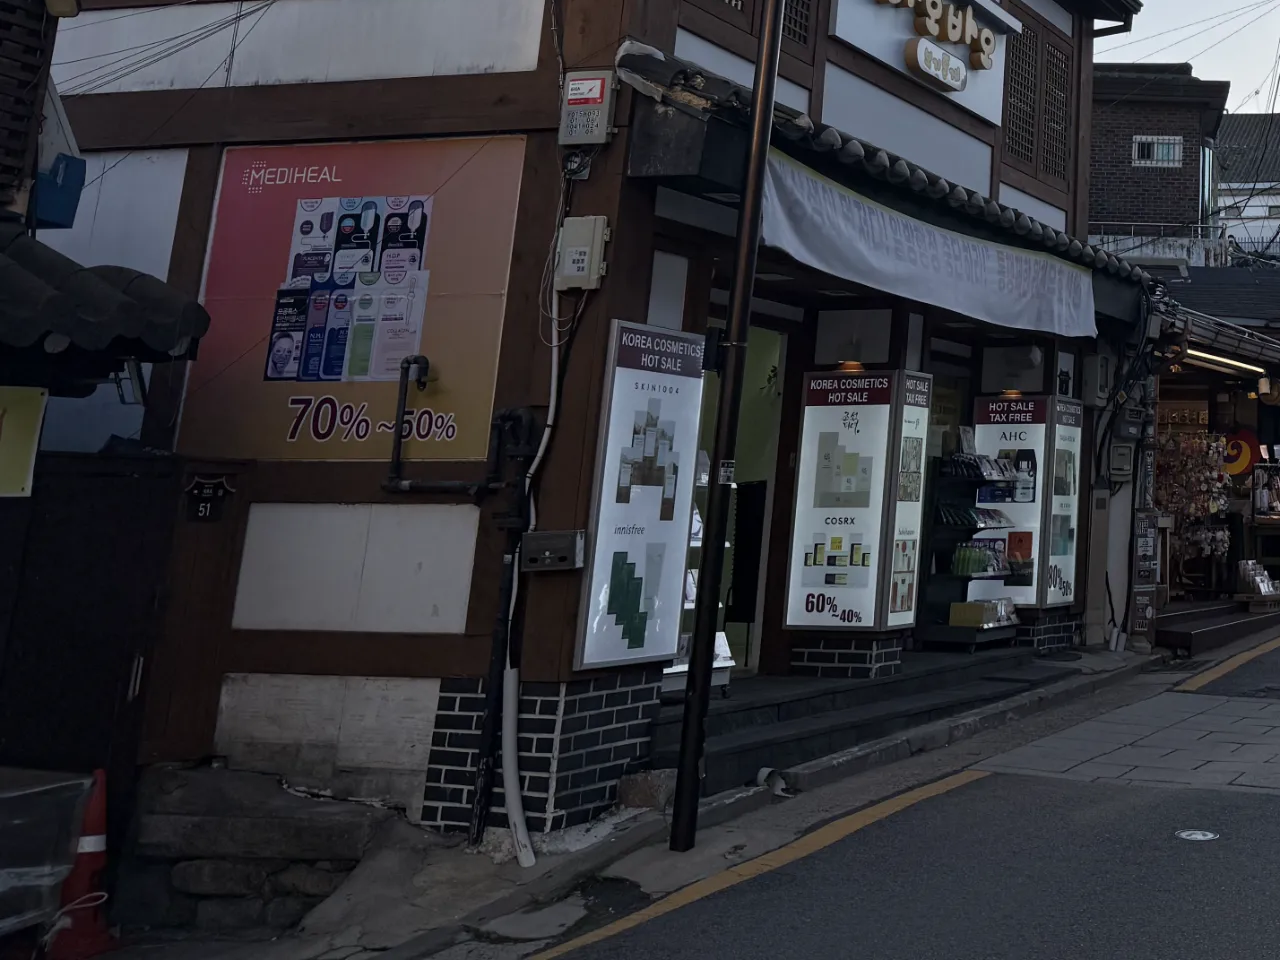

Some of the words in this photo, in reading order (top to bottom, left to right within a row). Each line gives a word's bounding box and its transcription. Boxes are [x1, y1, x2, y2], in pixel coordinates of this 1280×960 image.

[249, 166, 343, 185] MEDIHEAL
[622, 333, 653, 350] KOREA
[654, 338, 702, 358] COSMETICS
[641, 353, 659, 368] HOT
[660, 356, 682, 372] SALE
[634, 382, 680, 395] SKIN1004
[810, 379, 839, 390] KOREA
[840, 378, 889, 389] COSMETICS
[906, 380, 917, 390] HOT
[917, 382, 929, 393] SALE
[828, 392, 846, 403] HOT
[847, 392, 869, 402] SALE
[906, 393, 916, 404] TAX
[916, 396, 927, 406] FREE
[989, 403, 1009, 412] HOT
[1010, 401, 1035, 411] SALE
[989, 414, 1007, 423] TAX
[1008, 413, 1033, 423] FREE
[999, 431, 1028, 442] AHC
[198, 502, 211, 517] 51
[824, 517, 856, 526] COSRX
[614, 524, 646, 536] innisfree
